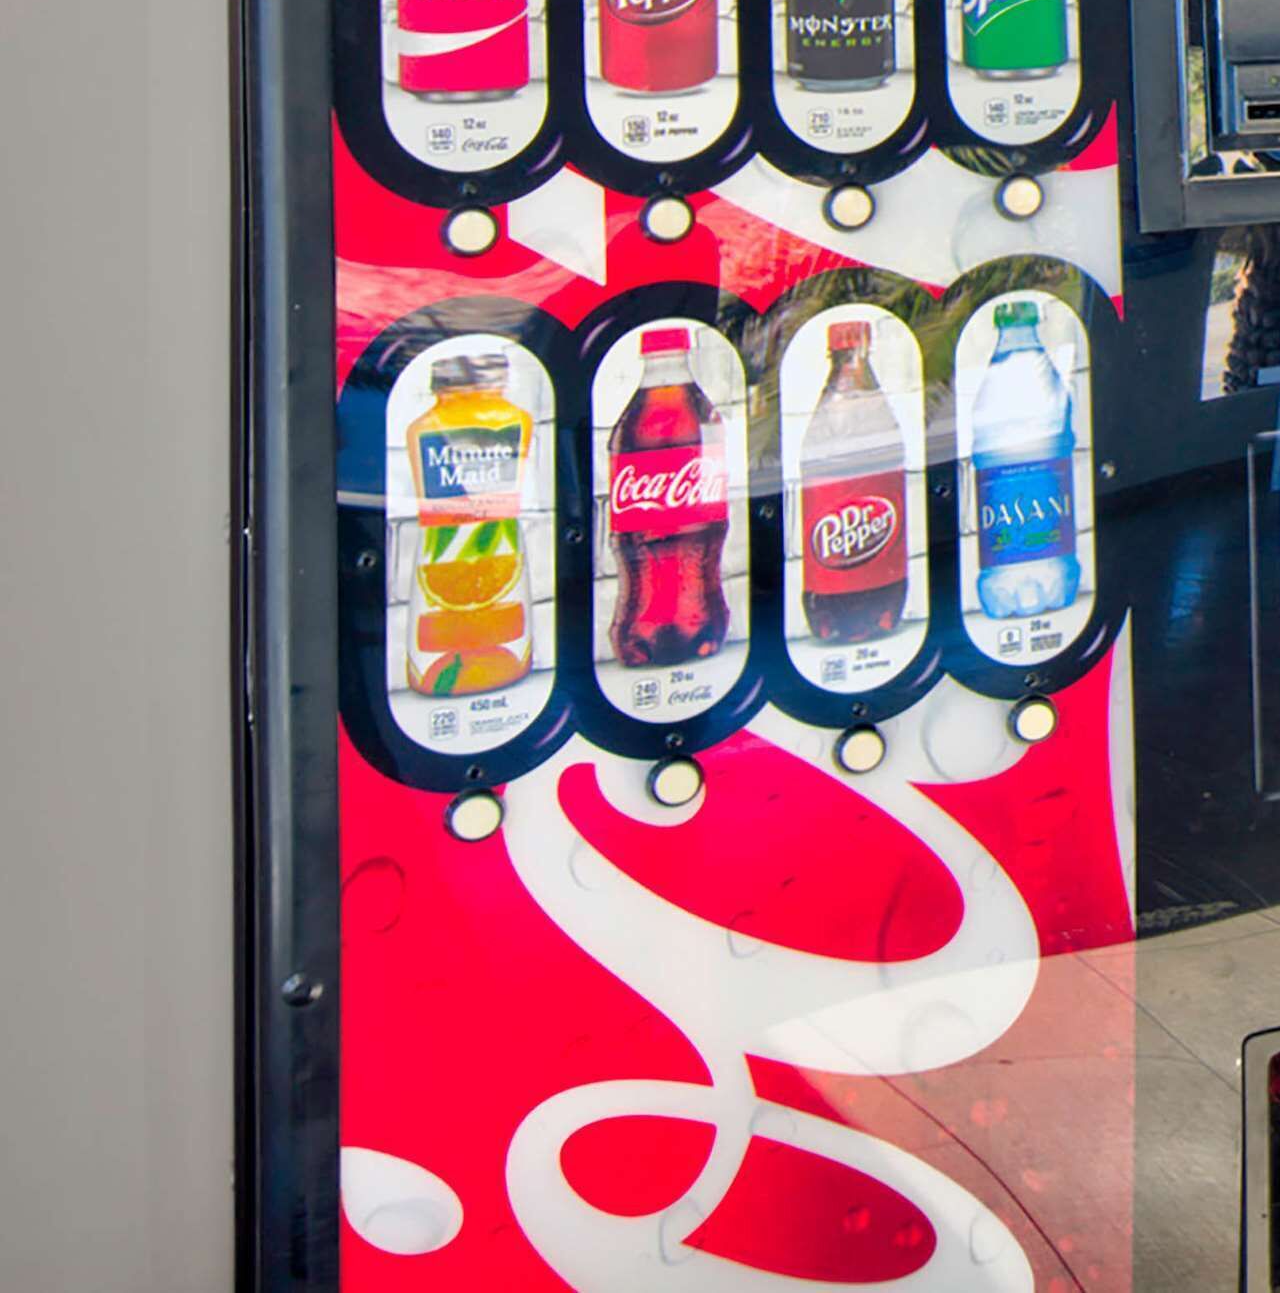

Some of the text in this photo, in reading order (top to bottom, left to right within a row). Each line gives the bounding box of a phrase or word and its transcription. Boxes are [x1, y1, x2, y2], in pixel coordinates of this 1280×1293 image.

[789, 14, 893, 37] MONSTER
[440, 464, 500, 487] Maid
[611, 459, 727, 514] Coca-Cola
[838, 506, 873, 532] Dr
[982, 495, 1070, 529] DASANI
[819, 509, 894, 555] Pepper
